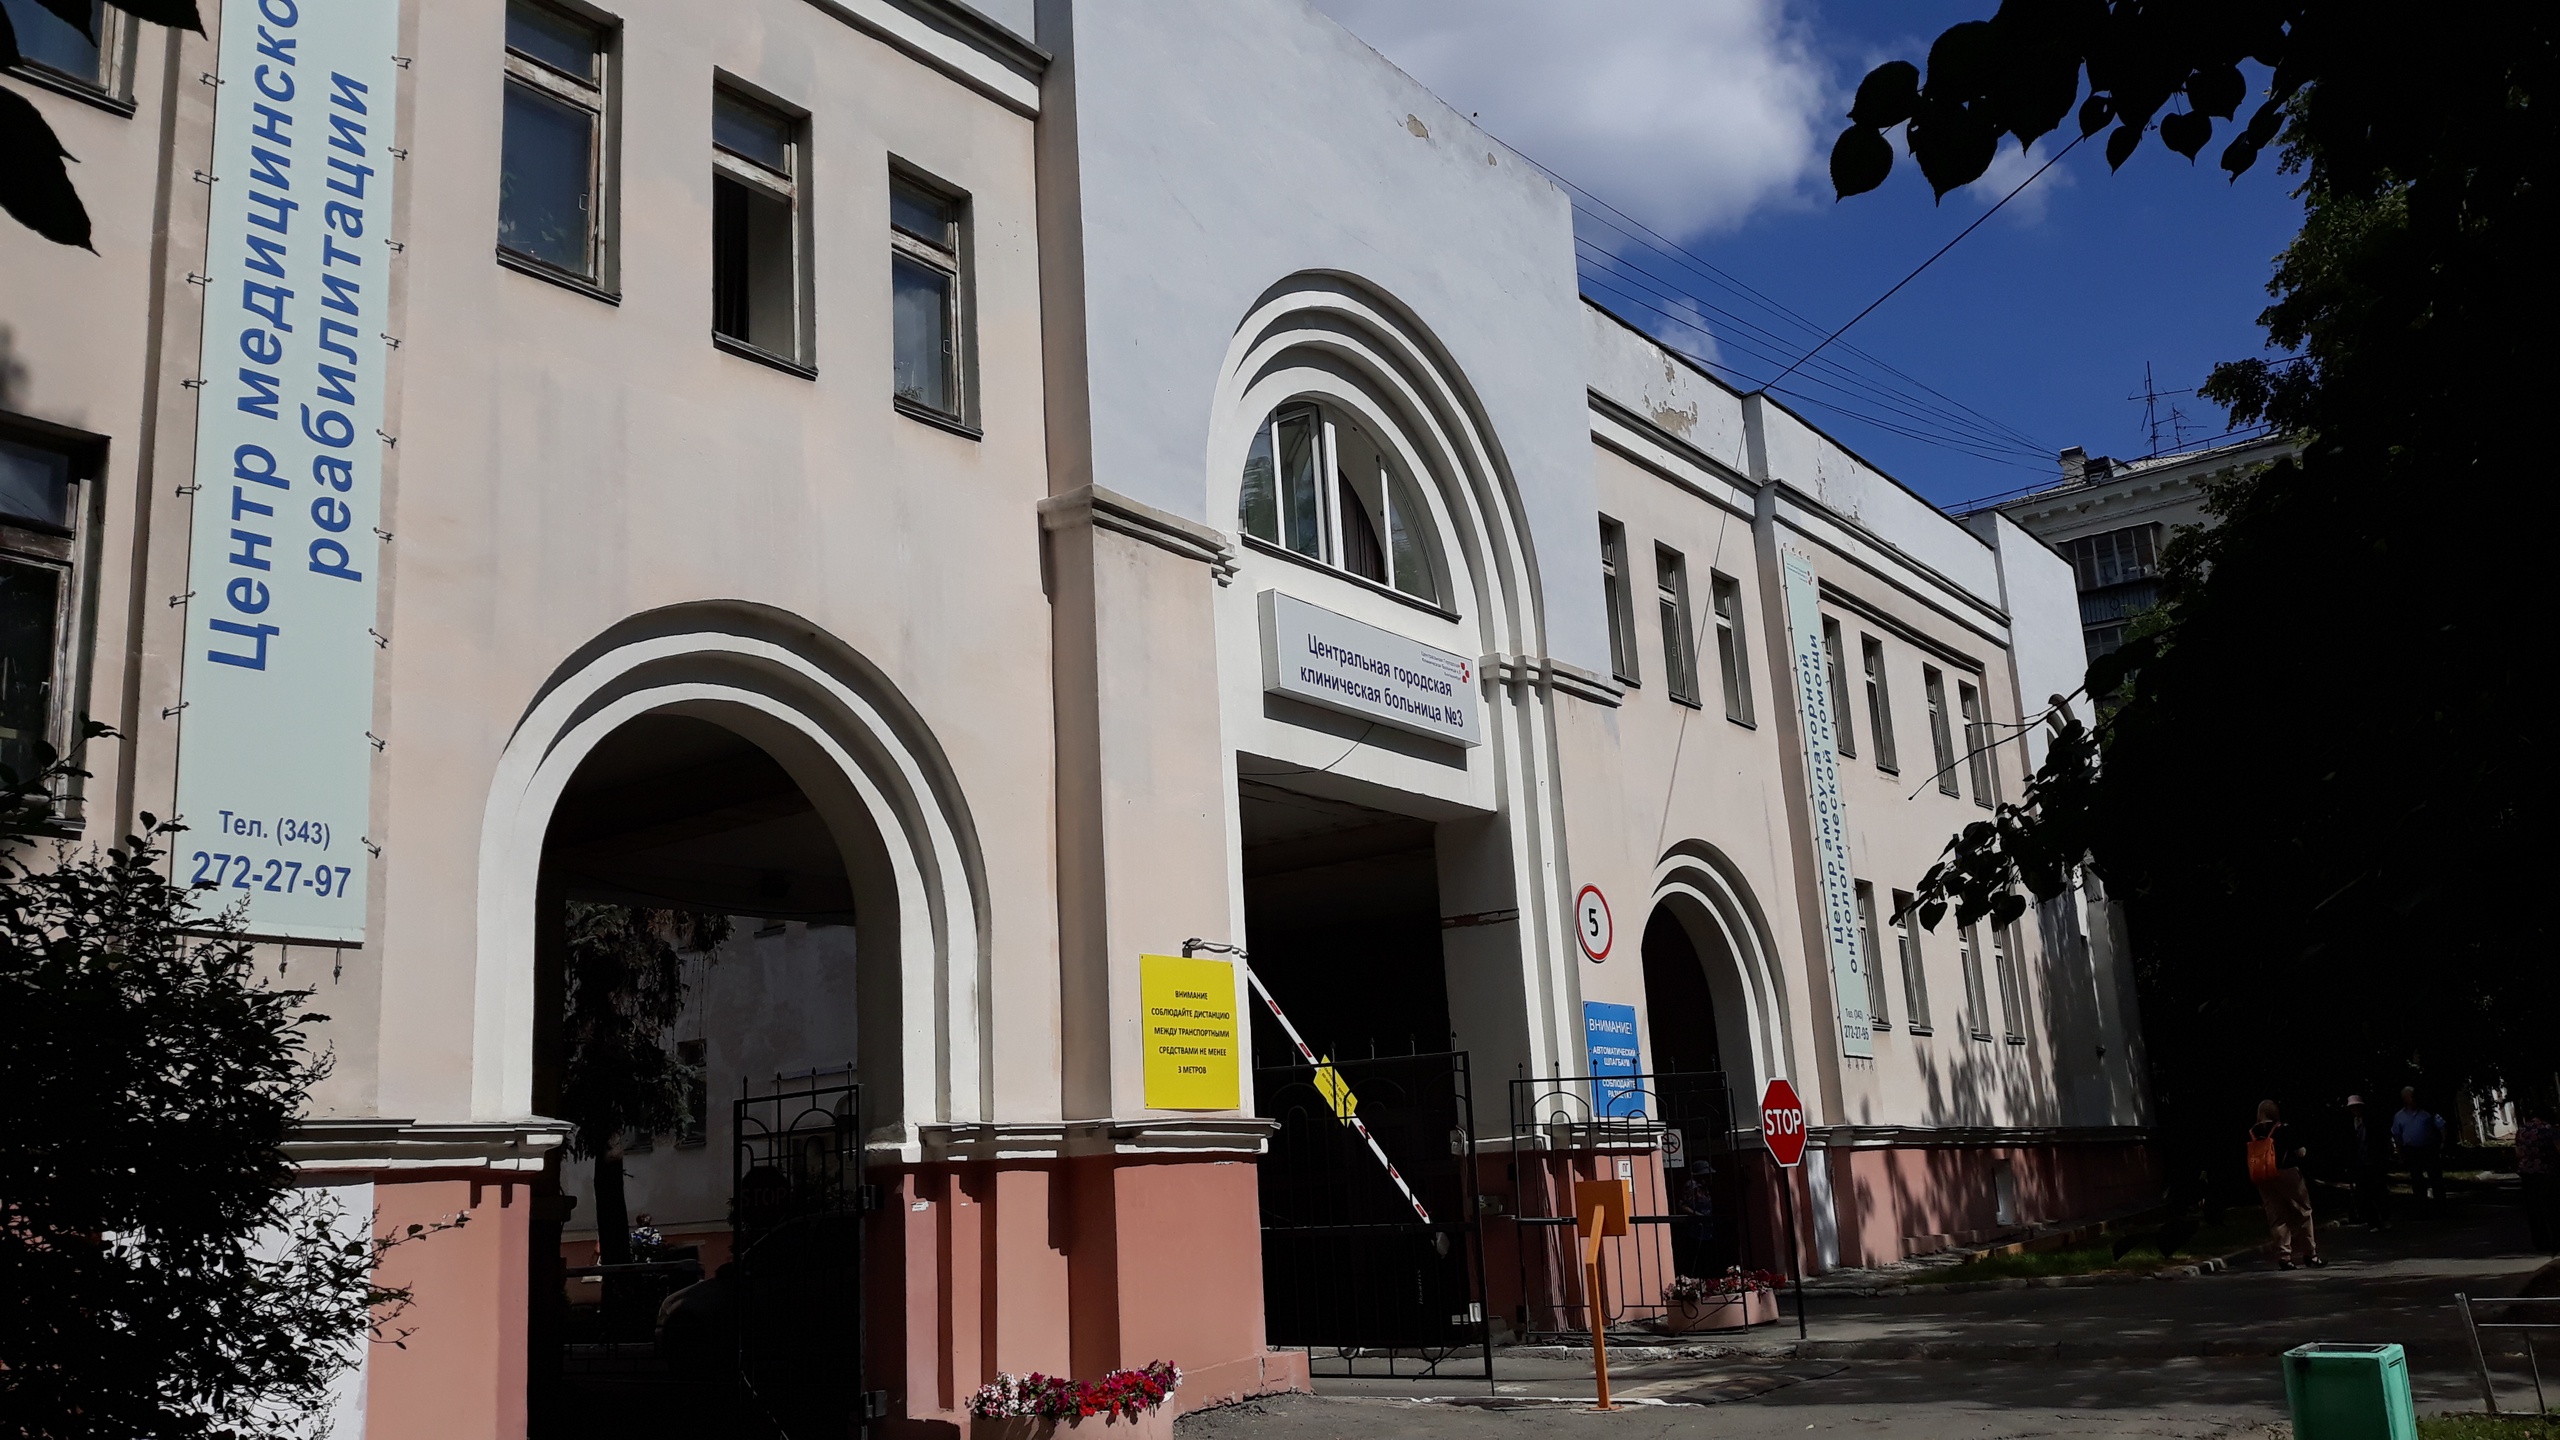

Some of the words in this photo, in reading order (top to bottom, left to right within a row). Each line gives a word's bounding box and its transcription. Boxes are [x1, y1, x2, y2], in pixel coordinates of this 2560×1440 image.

[237, 0, 300, 421] медицинско
[301, 70, 375, 583] реабилитации
[208, 443, 290, 672] Центр
[1307, 633, 1391, 678] Центральная
[1393, 666, 1453, 697] городская
[1300, 666, 1382, 704] клиническая
[1384, 687, 1442, 723] больница
[1444, 705, 1465, 728] №3
[1809, 634, 1829, 741] помощи
[1799, 653, 1833, 852] амбулаторной
[218, 809, 269, 839] Тел.
[276, 817, 331, 852] (343)
[190, 850, 352, 899] 272-27-97
[1822, 749, 1858, 974] онкологической
[1588, 907, 1599, 937] 5
[1827, 861, 1844, 945] Центр
[1151, 1007, 1193, 1018] СОБЛЮДАЙТЕ
[1193, 1010, 1230, 1020] ДИСТАНЦИЮ
[1174, 990, 1208, 1000] ВНИМАНИЕ
[1154, 1026, 1178, 1036] МЕЖДУ
[1178, 1027, 1230, 1038] ТРАНСПОРТНЫМИ
[1589, 1018, 1633, 1035] ВНИМАНИЕ!
[1159, 1046, 1199, 1056] СРЕДСТВАМИ
[1199, 1048, 1207, 1056] НЕ
[1208, 1048, 1227, 1056] МЕНЕЕ
[1178, 1066, 1182, 1074] 3
[1183, 1066, 1207, 1074] МЕТРОВ
[1592, 1045, 1637, 1056] АВТОМАТИЧЕСКИЙ
[1764, 1108, 1802, 1136] STOP
[742, 1186, 788, 1208] STOP
